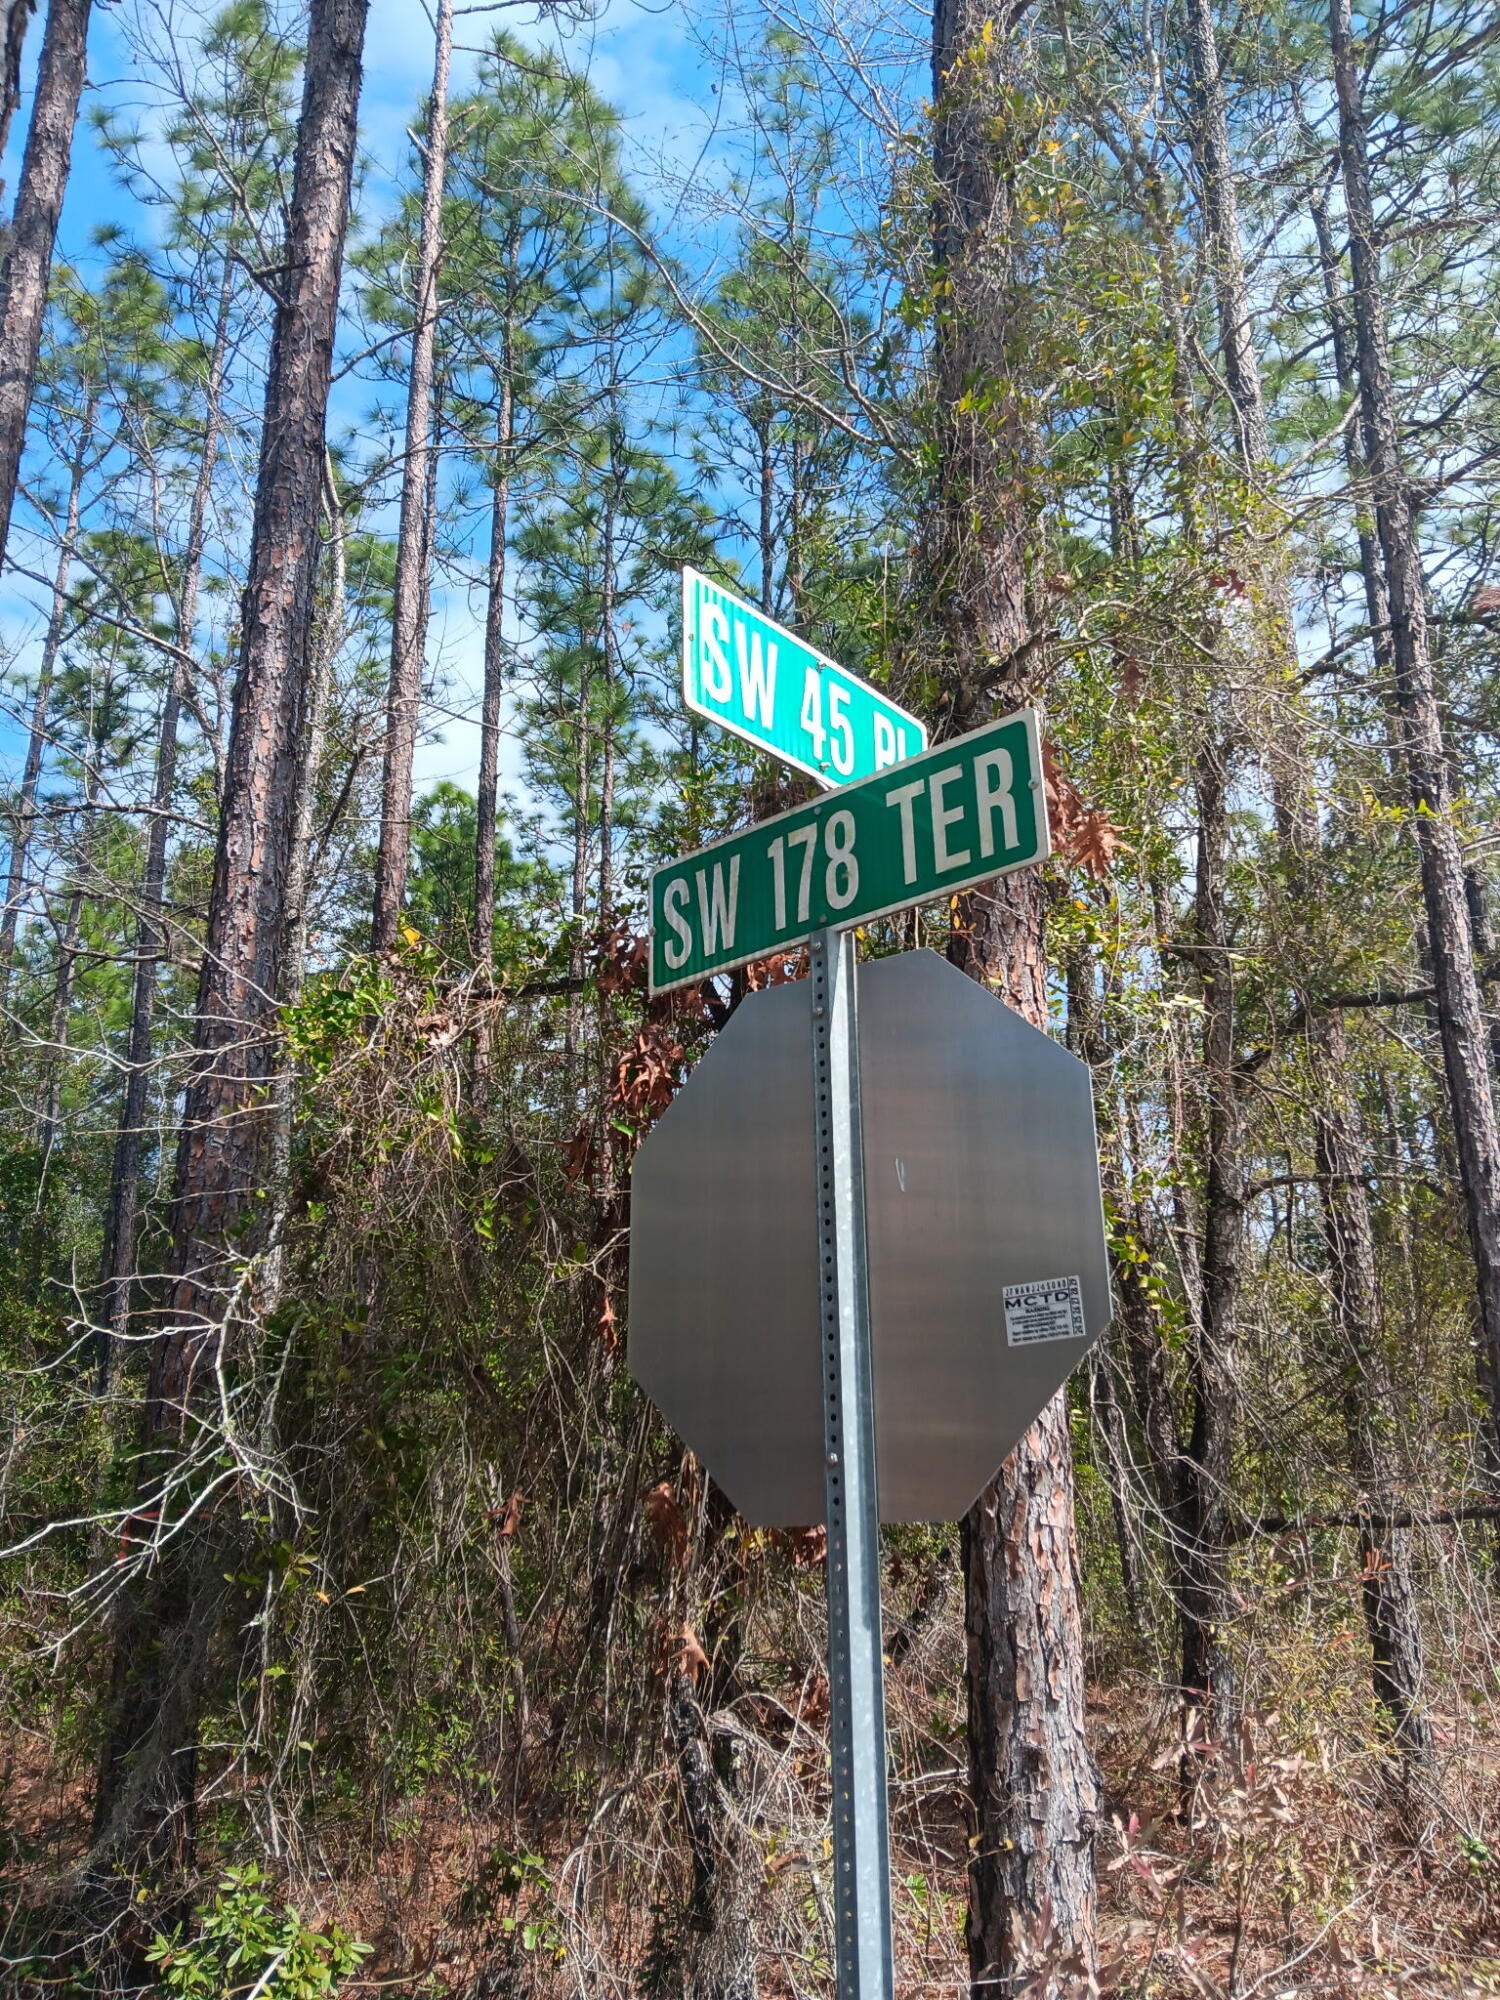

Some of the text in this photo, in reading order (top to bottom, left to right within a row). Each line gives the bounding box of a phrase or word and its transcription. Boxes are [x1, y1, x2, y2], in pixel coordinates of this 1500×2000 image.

[701, 602, 778, 730] SW
[800, 666, 855, 776] 45
[663, 747, 1020, 970] SW 178 TER
[1005, 1291, 1069, 1310] MCTD
